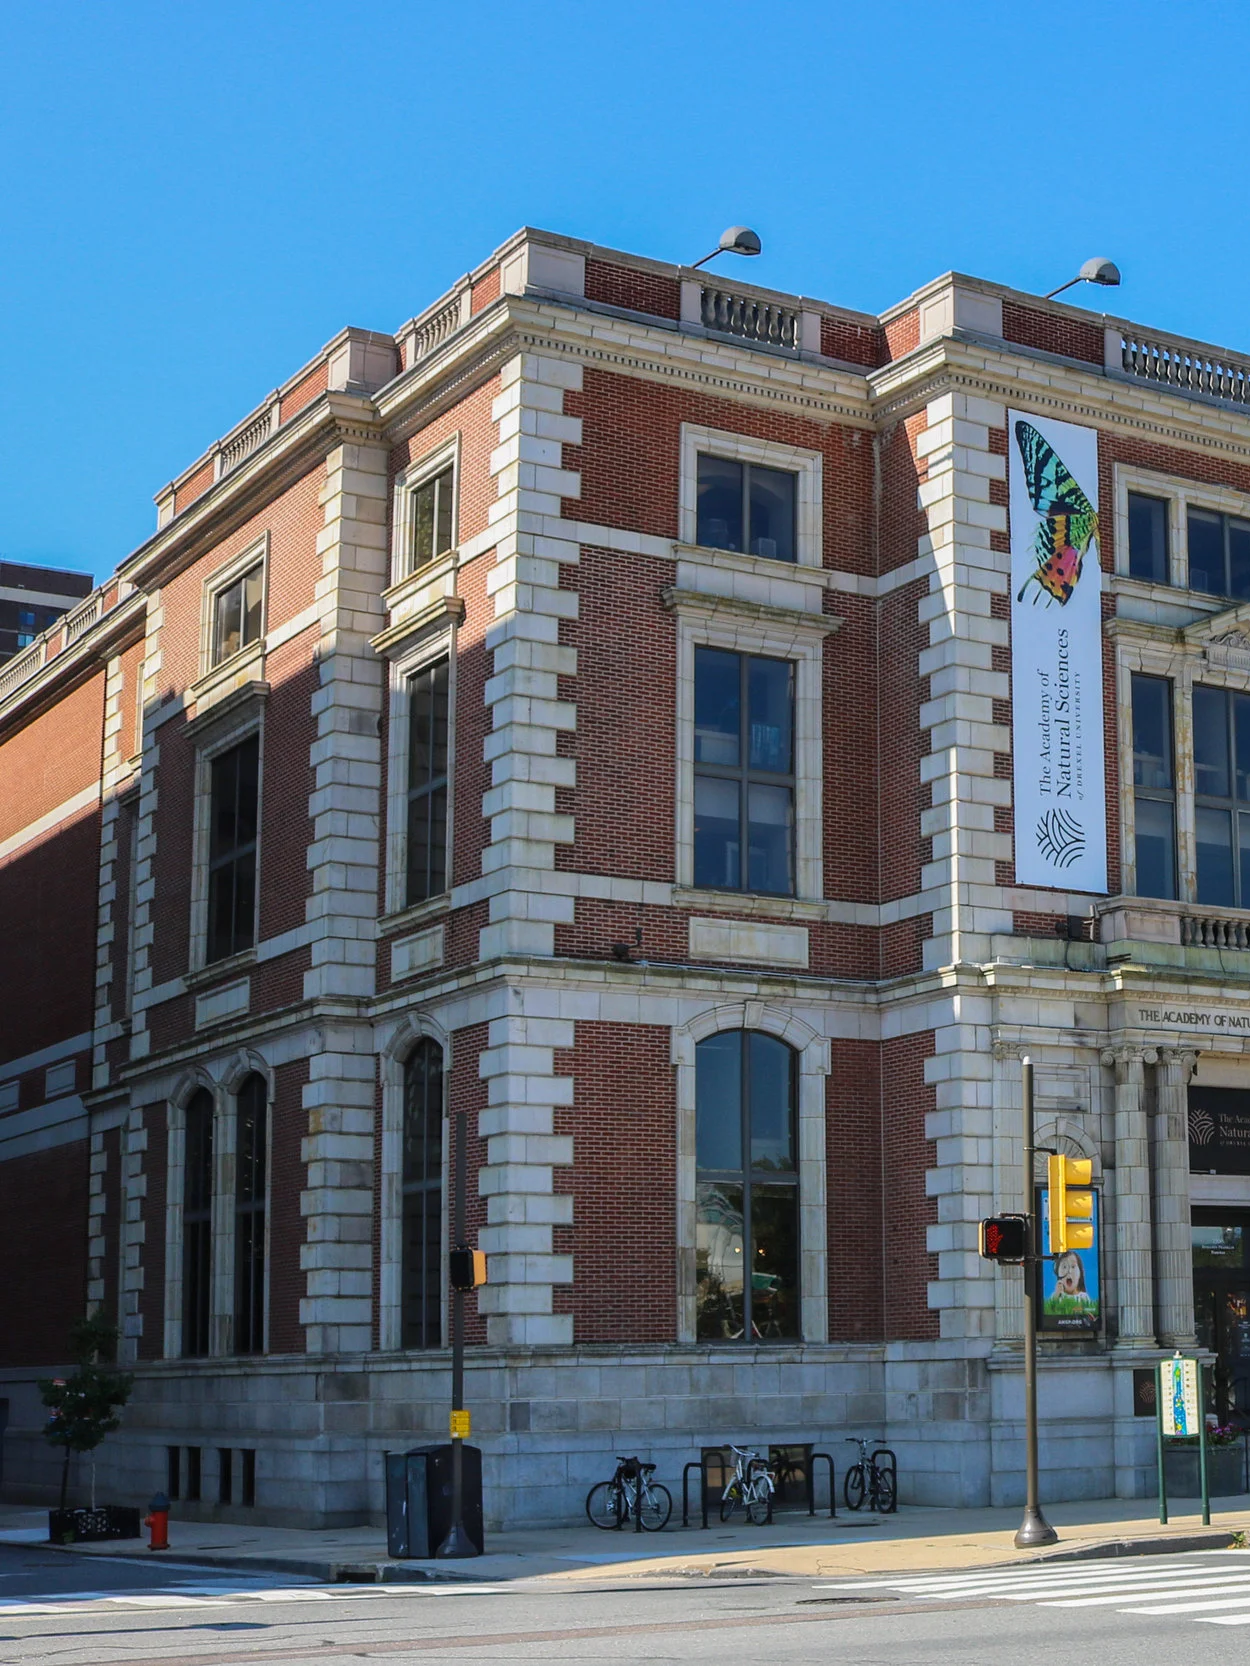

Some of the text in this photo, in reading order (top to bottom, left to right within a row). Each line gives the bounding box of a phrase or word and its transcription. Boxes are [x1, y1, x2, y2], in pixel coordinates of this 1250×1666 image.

[1037, 668, 1052, 796] The Academy of
[1054, 628, 1072, 798] Natural Sciences
[1138, 1009, 1160, 1022] THE
[1162, 1011, 1211, 1026] ACADEMY
[1213, 1015, 1227, 1027] OF
[1218, 1113, 1231, 1123] The
